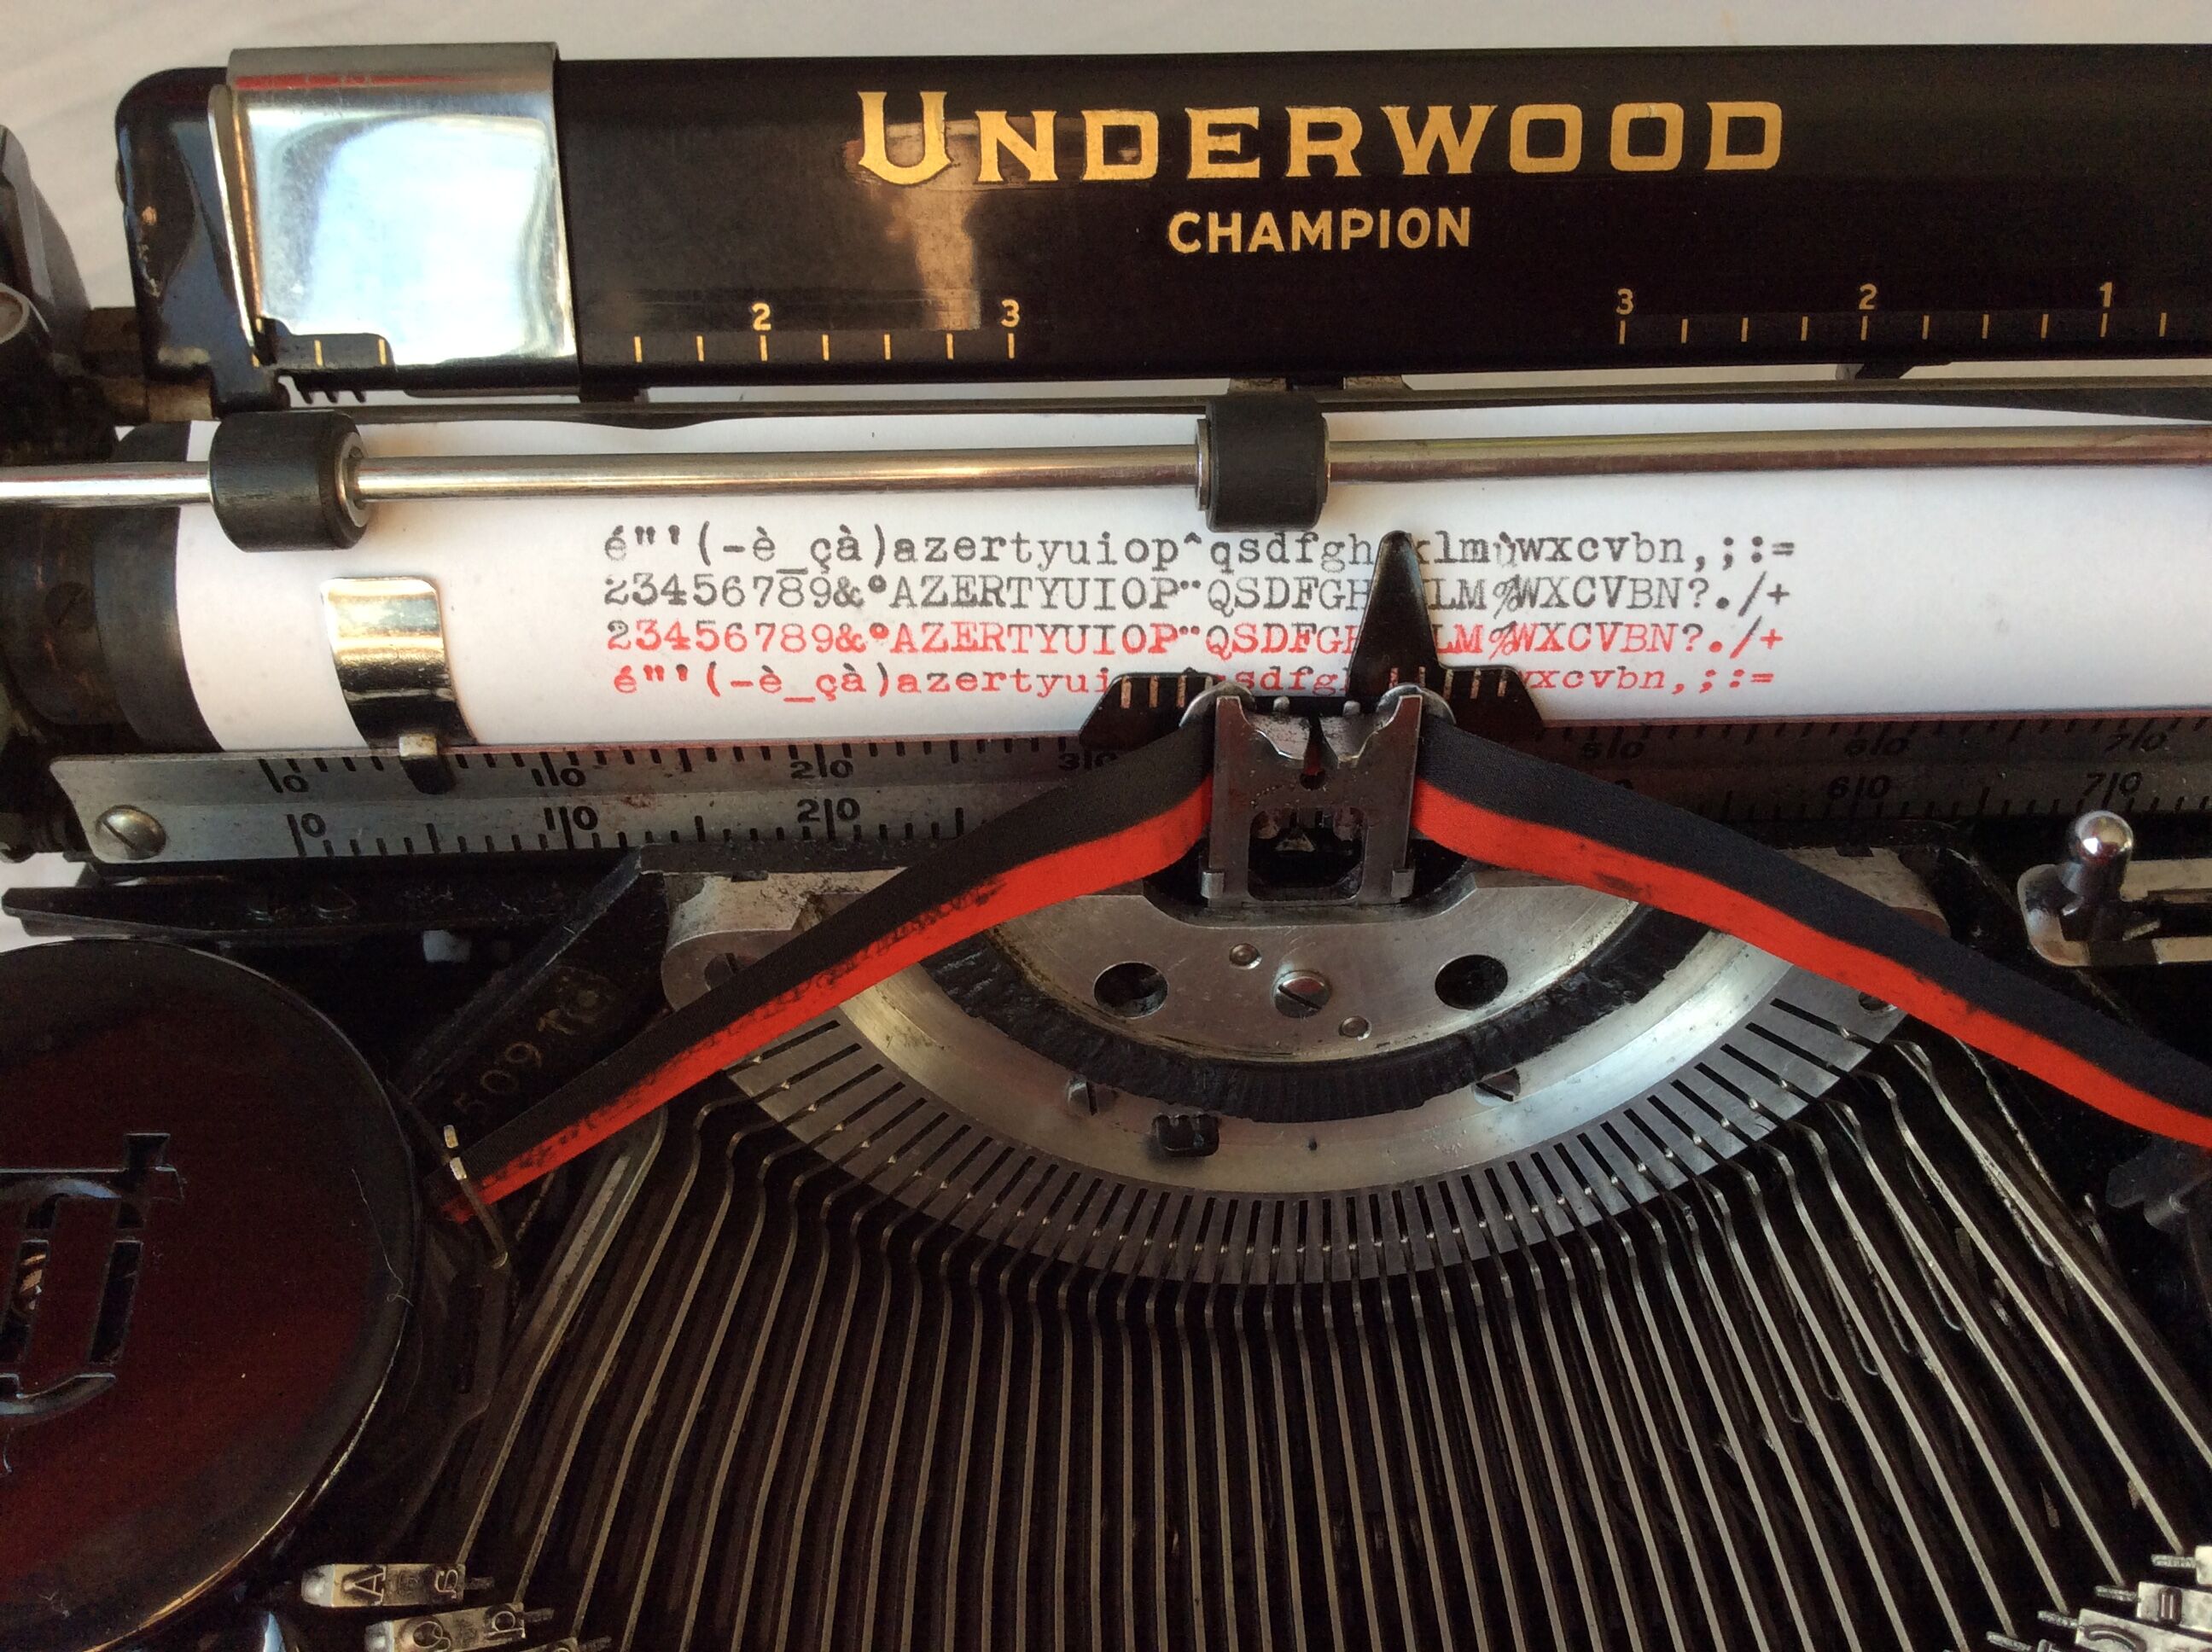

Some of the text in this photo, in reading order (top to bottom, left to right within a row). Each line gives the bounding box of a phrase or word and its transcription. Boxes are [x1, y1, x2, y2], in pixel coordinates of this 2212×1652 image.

[857, 90, 1784, 186] UNDERWOOD
[1168, 206, 1472, 255] CHAMPION
[751, 299, 1021, 331] 2 3
[1615, 282, 2115, 316] 3 2 1
